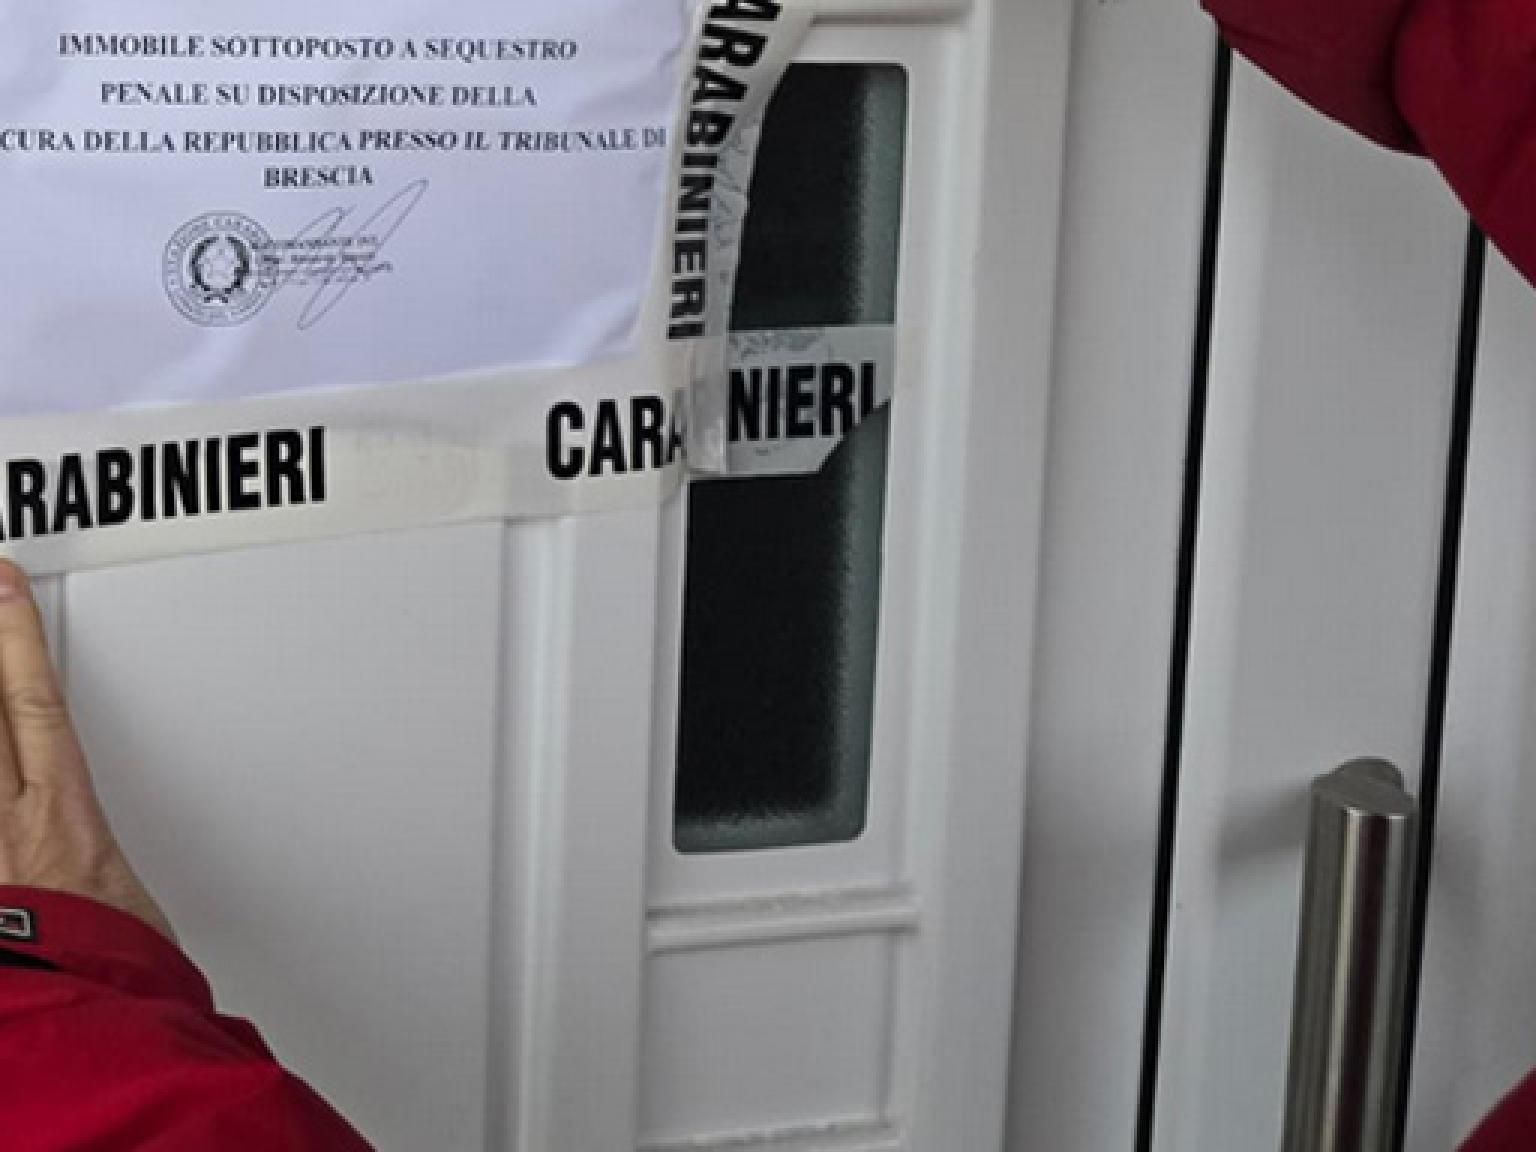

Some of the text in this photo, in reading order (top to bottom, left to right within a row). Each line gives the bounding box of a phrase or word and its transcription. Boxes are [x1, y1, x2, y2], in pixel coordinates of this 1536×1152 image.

[59, 32, 577, 64] IMMOBILE SOTTOPOSTO A SEQUESTRO
[100, 81, 538, 107] PENALE SU DISPOSIZIONE DELLA
[82, 130, 176, 153] DELLA
[183, 130, 353, 153] REPUBBLICA
[358, 129, 458, 152] PRESSO
[463, 130, 491, 151] IL
[496, 127, 638, 152] TRIBUNALE
[641, 125, 667, 149] DI
[263, 164, 374, 190] BRESCIA
